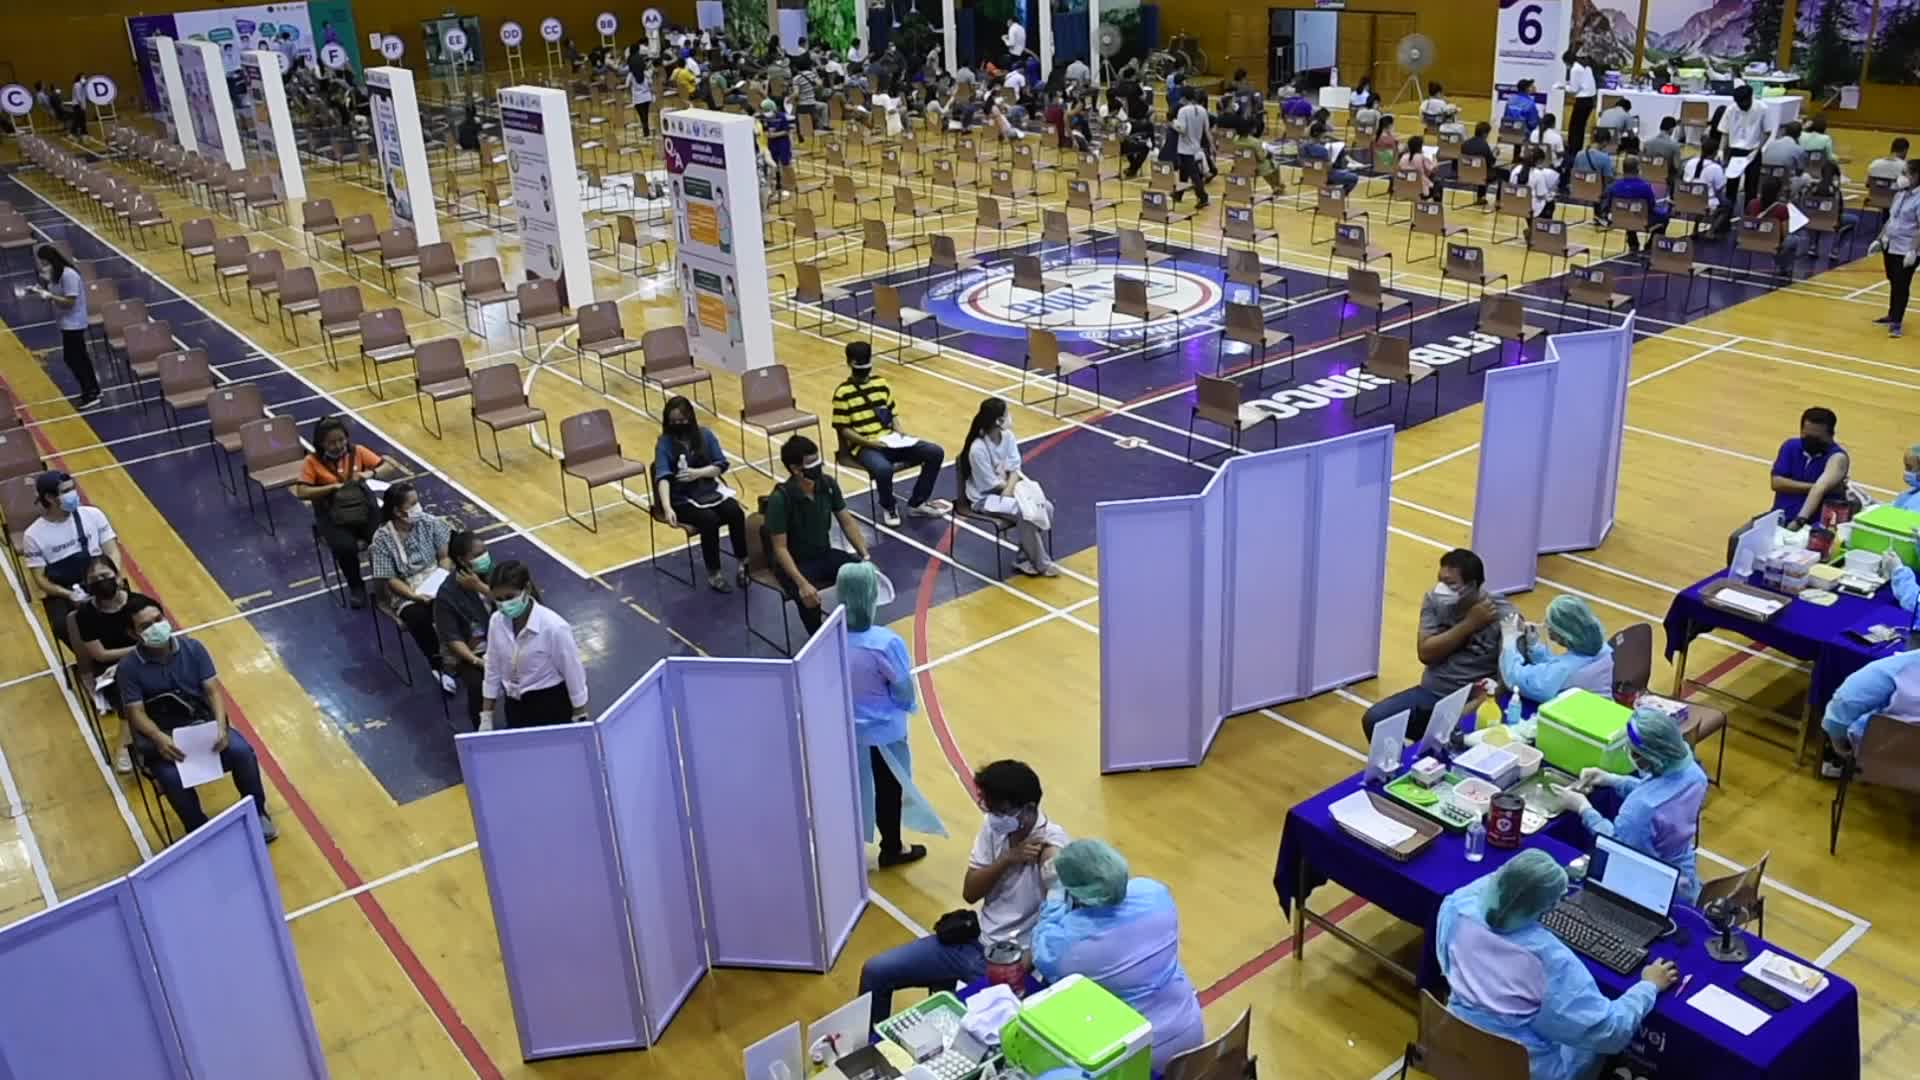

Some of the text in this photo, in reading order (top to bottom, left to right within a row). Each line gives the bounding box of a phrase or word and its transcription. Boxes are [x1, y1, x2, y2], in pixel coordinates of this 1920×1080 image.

[599, 19, 614, 29] BB
[644, 14, 659, 25] AA
[1518, 4, 1543, 46] 6
[503, 29, 519, 40] DD
[543, 24, 560, 35] CC
[448, 35, 463, 46] EE
[384, 42, 400, 53] FF
[327, 49, 339, 64] F
[93, 82, 109, 97] D
[7, 90, 25, 107] C
